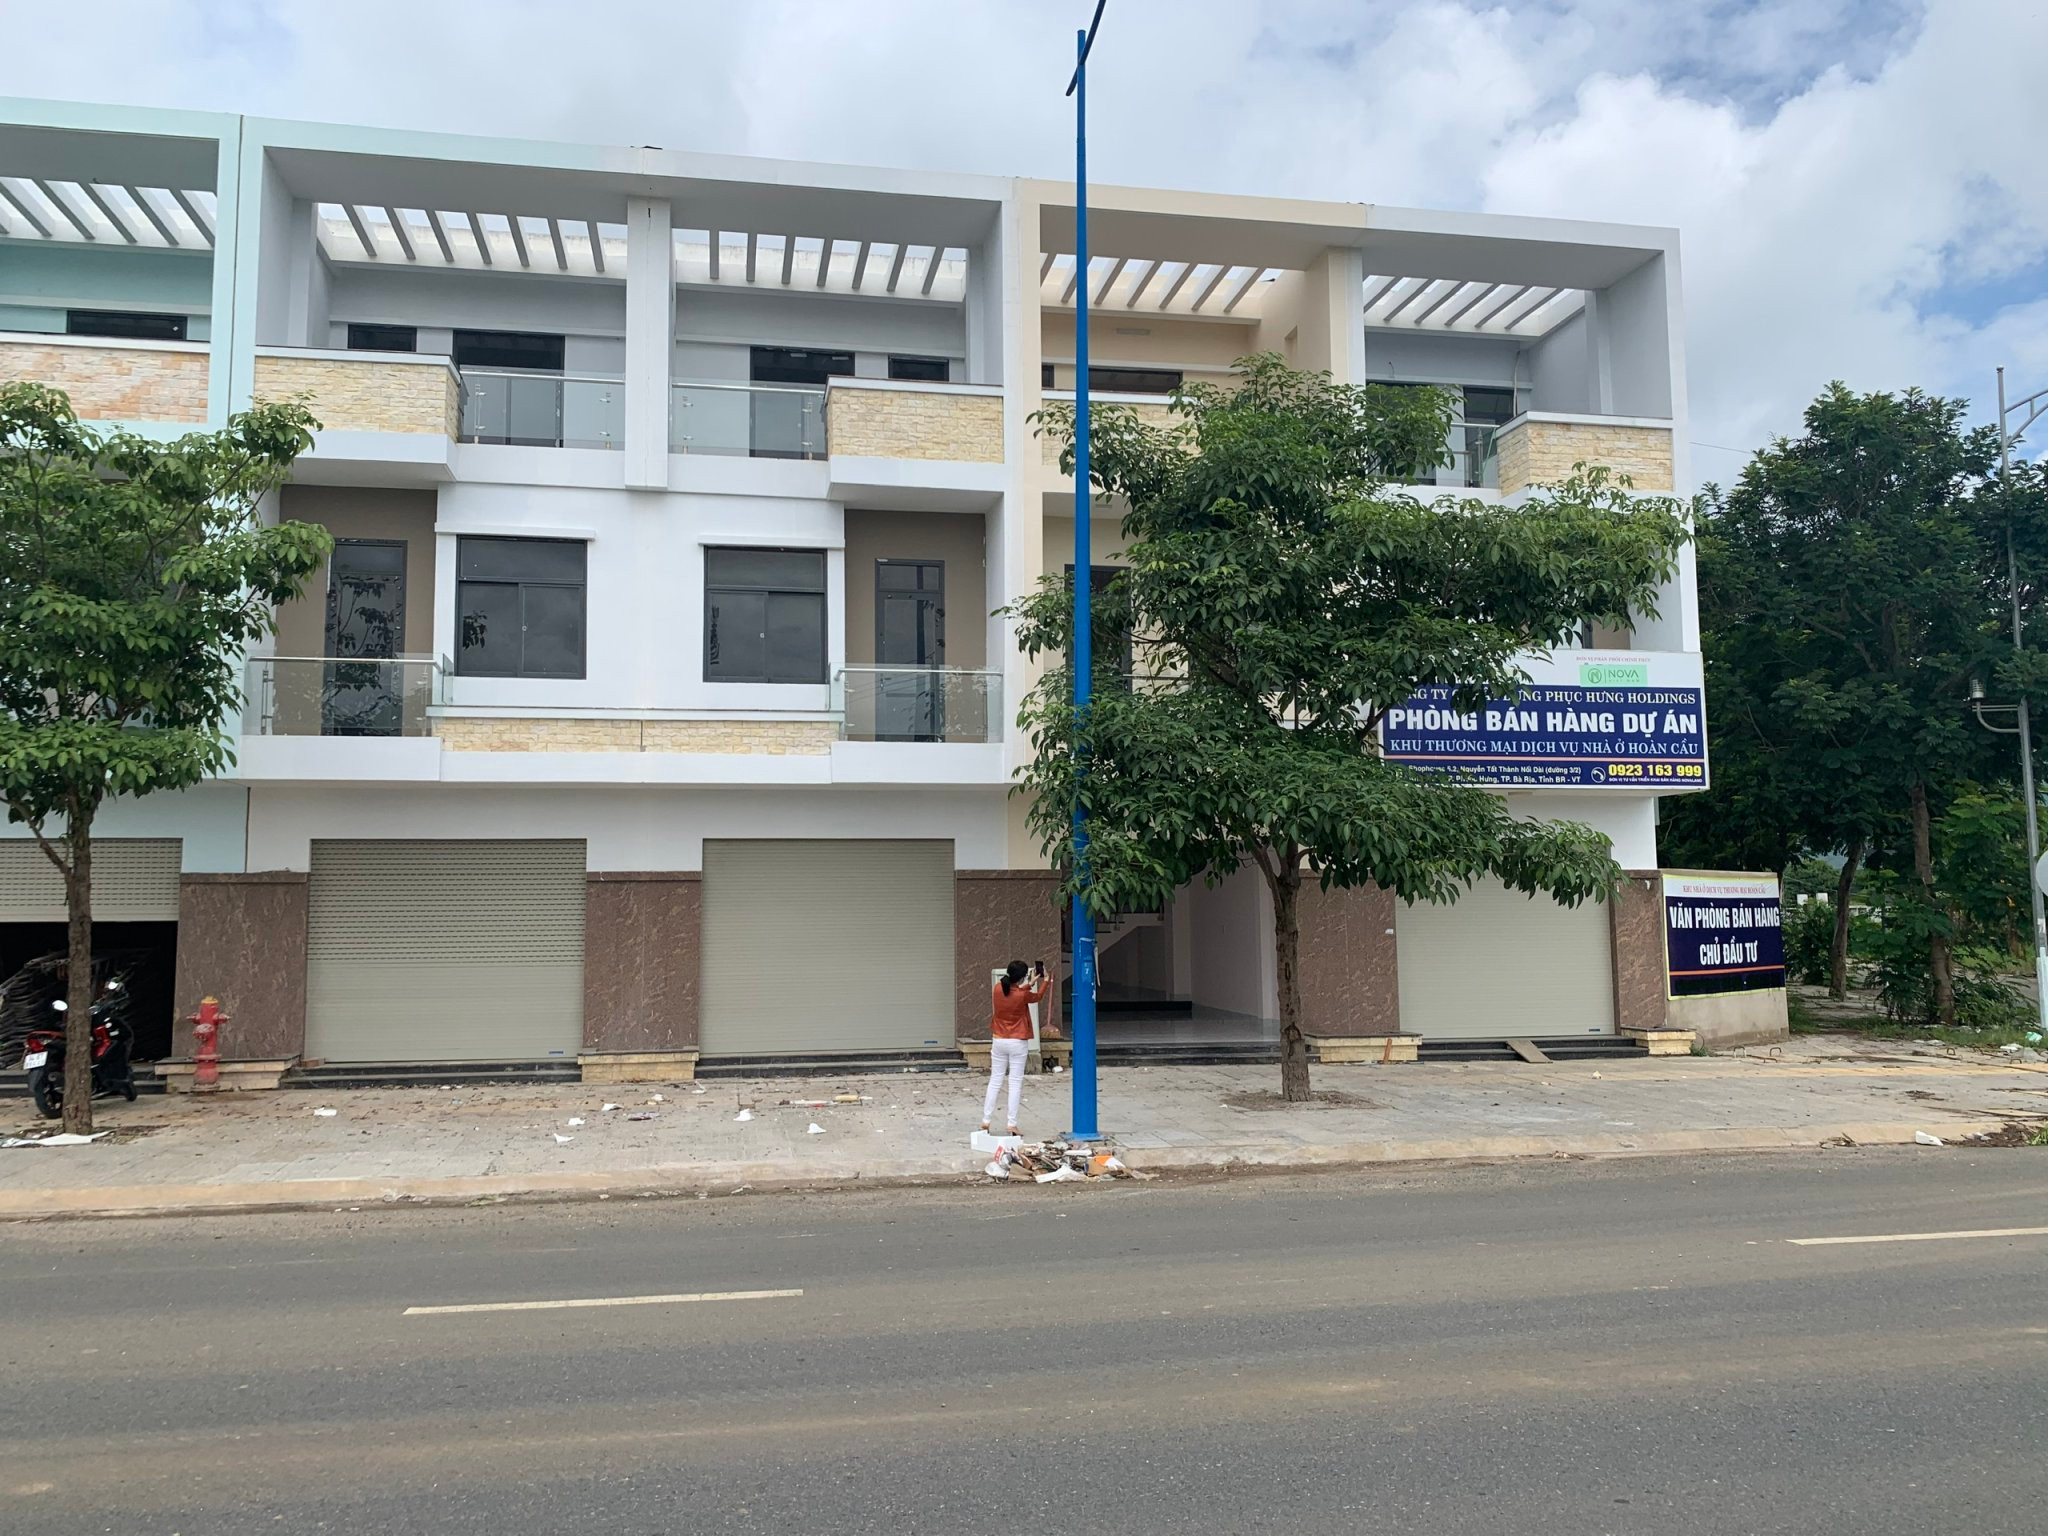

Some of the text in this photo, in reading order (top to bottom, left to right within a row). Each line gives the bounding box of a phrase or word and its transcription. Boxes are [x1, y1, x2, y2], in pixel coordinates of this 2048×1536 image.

[1608, 669, 1639, 678] NOVA
[1431, 688, 1448, 700] TY
[1545, 691, 1583, 704] PHỤC
[1586, 690, 1624, 703] HƯNG
[1628, 692, 1696, 704] HOLDINGS
[1389, 704, 1697, 737] PHÒNG BÁN HÀNG DỰ ÁN
[1390, 738, 1698, 756] KHU THƯƠNG MẠI DỊCH VỤ NHÀ Ở HOÀN CẦU
[1498, 765, 1519, 773] Thành
[1521, 764, 1532, 773] Nối
[1533, 765, 1544, 773] Dài
[1545, 766, 1568, 775] (đường
[1569, 767, 1581, 775] 3/2)
[1608, 763, 1702, 777] 0923 163 999
[1513, 775, 1523, 783] Bà
[1669, 902, 1780, 929] VĂN PHÒNG BÁN HÀNG
[1699, 936, 1758, 965] CHỦ ĐẦU TƯ
